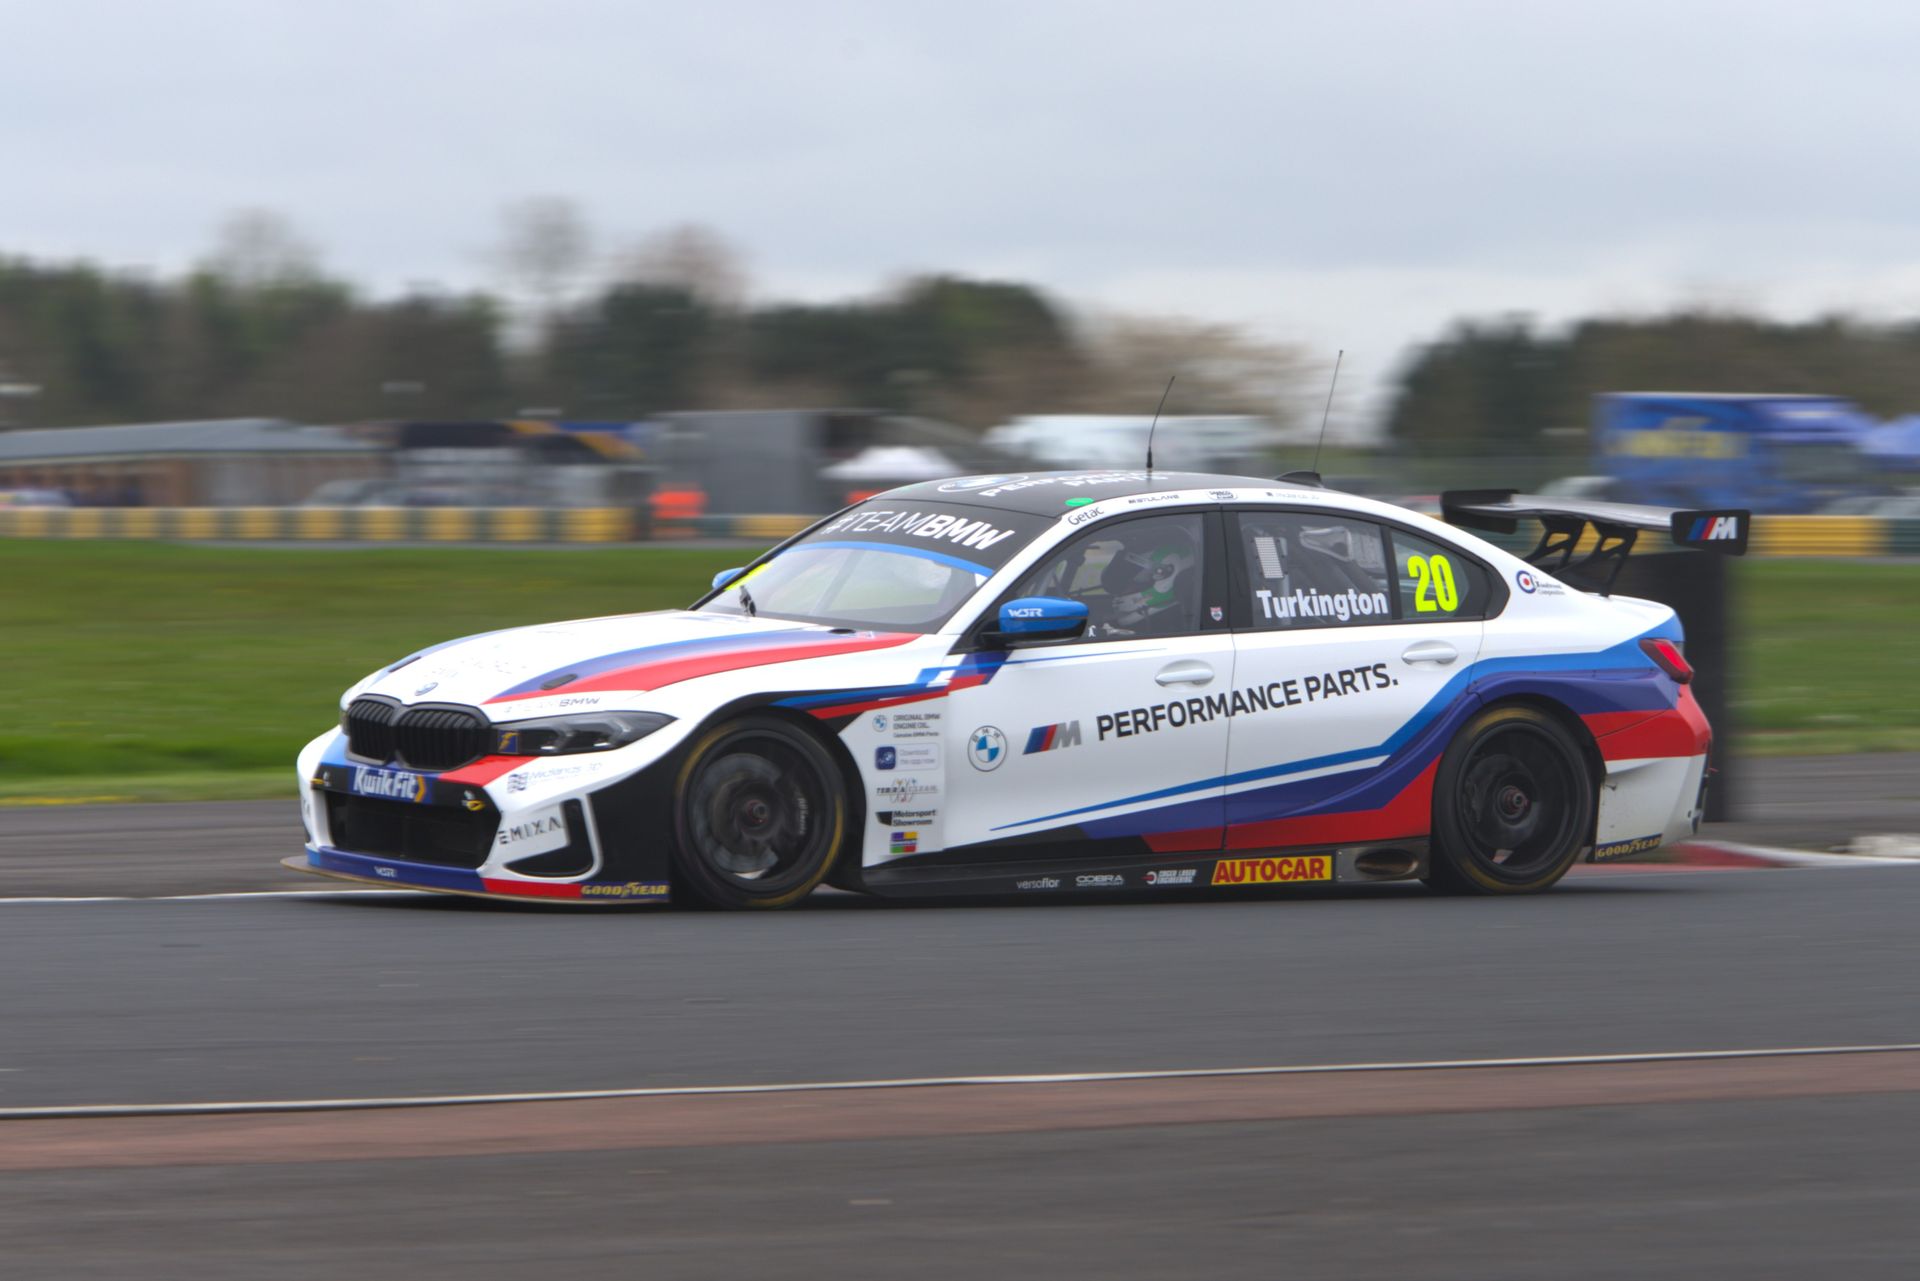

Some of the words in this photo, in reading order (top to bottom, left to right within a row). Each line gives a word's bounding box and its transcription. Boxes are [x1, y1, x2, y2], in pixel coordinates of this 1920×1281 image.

[1068, 506, 1104, 526] Getac
[1408, 554, 1458, 613] 20
[1256, 588, 1388, 621] Turkington
[1096, 679, 1301, 741] PERFORMANCE
[1304, 663, 1399, 701] PARTS.
[893, 809, 936, 818] Motorsport
[893, 818, 932, 826] Showroom
[1075, 874, 1124, 883] COBRA
[1214, 858, 1325, 884] AUTOCAR
[580, 881, 670, 897] GOODYEAR
